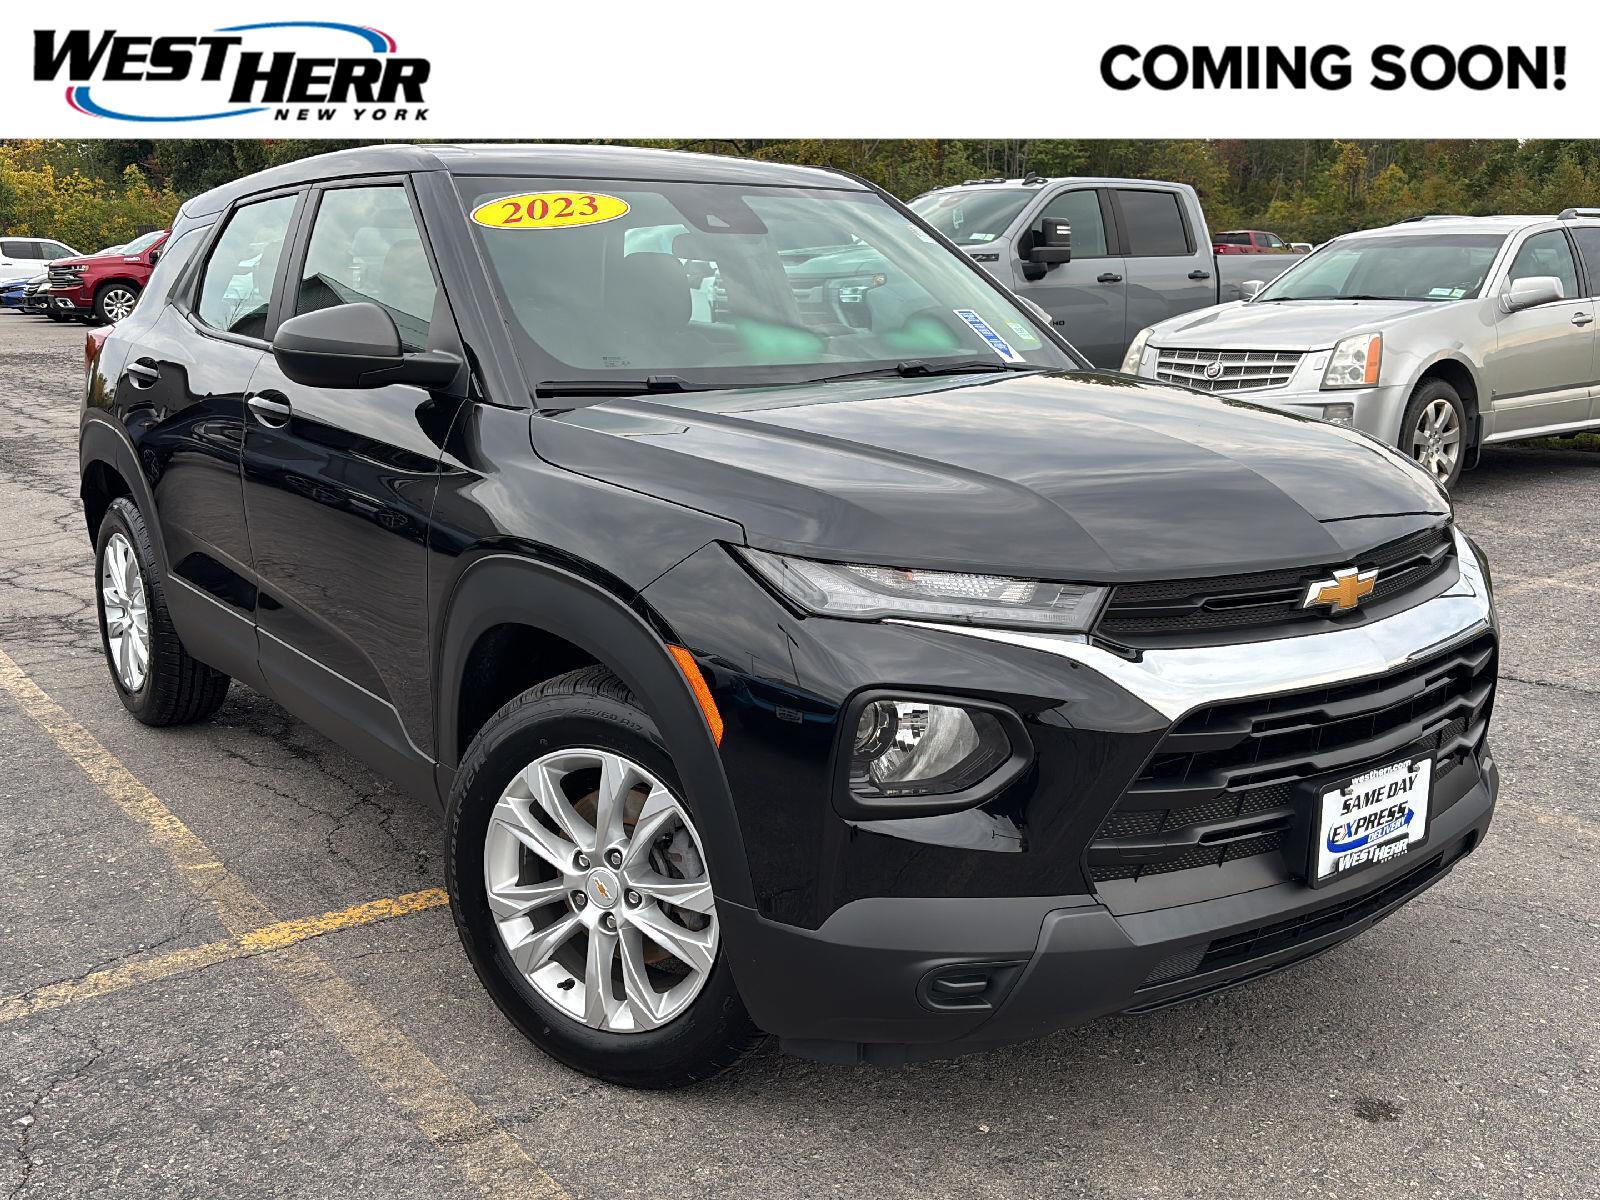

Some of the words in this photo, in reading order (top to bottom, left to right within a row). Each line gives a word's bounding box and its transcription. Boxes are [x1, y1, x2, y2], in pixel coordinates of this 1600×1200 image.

[501, 195, 599, 225] 2023
[1340, 785, 1386, 816] SAME
[1386, 773, 1418, 800] DAY
[1332, 800, 1409, 843] EXPRESS
